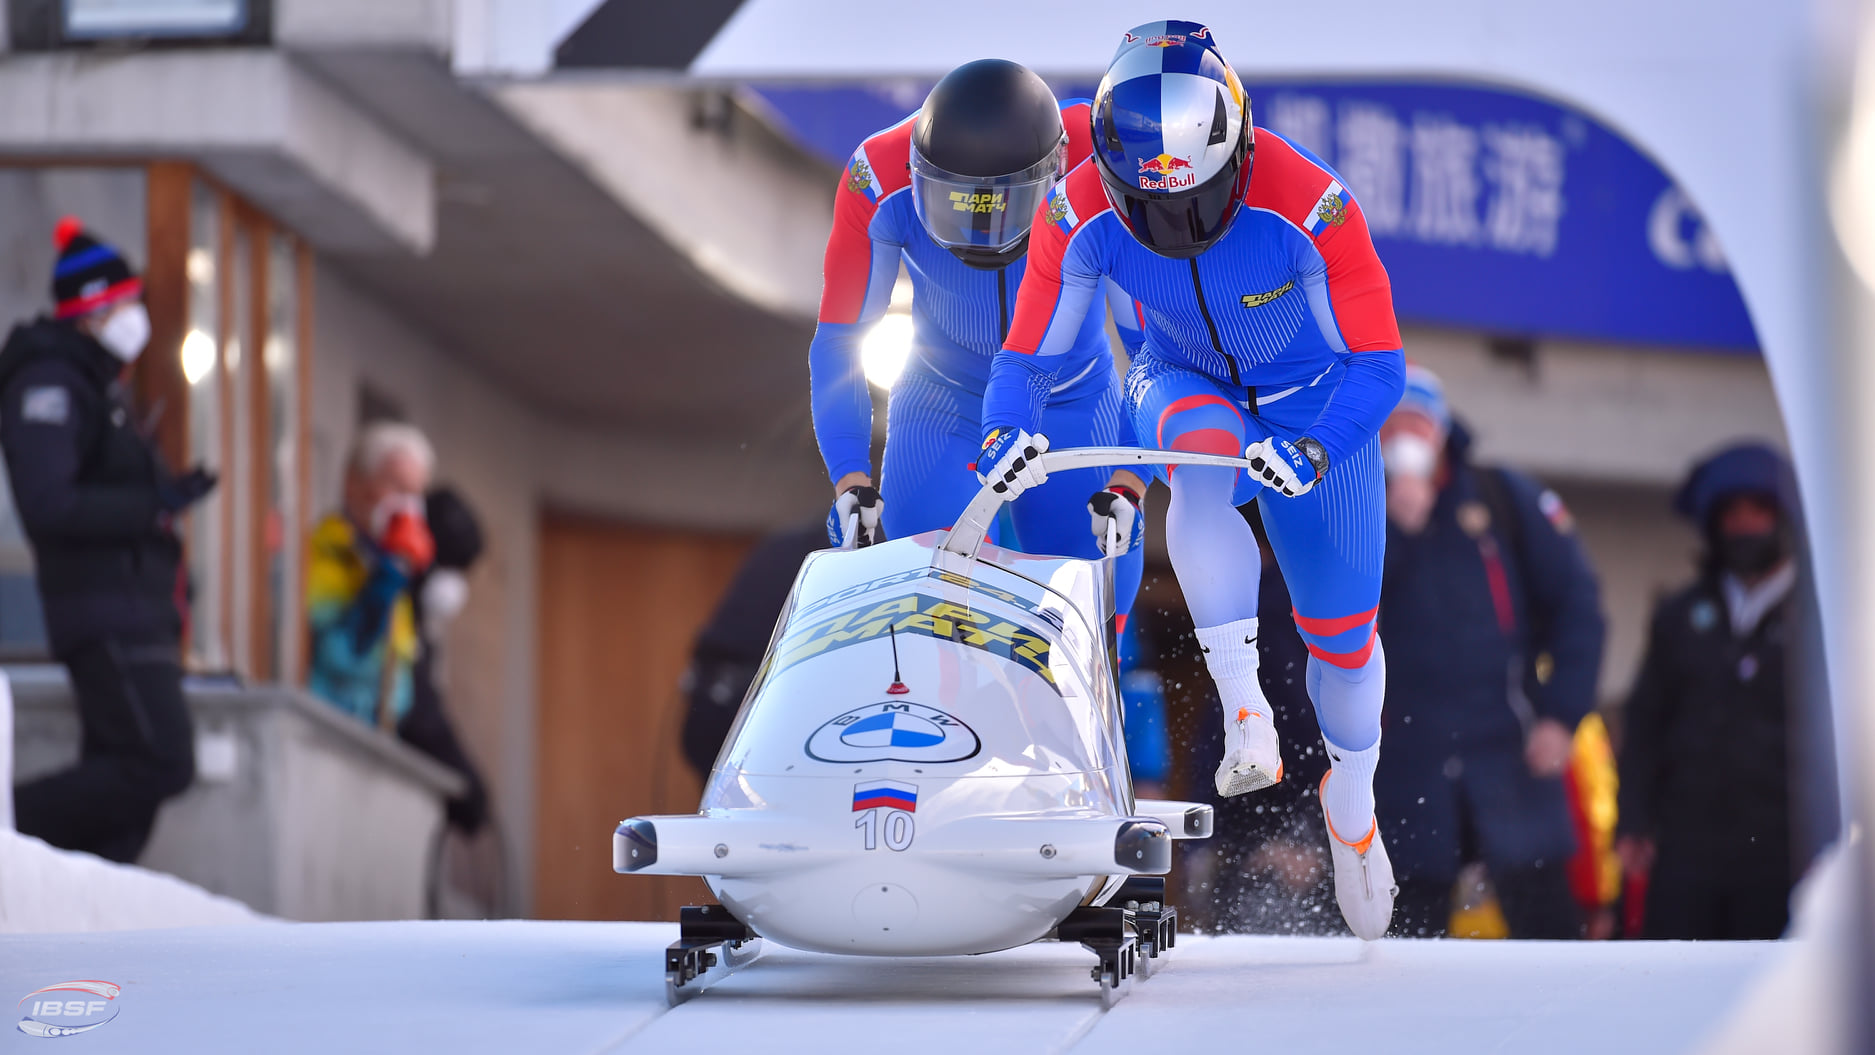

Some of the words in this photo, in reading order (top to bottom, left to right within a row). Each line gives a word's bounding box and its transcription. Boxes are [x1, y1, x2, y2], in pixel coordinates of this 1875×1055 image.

[1139, 176, 1167, 189] Red
[1169, 173, 1195, 188] Bull
[949, 192, 1003, 204] ПАРИ
[953, 201, 1007, 213] МАТЧ
[987, 432, 1012, 460] SEIZ
[1281, 440, 1303, 468] SEIZ
[832, 704, 960, 727] BMW
[855, 809, 915, 852] 10
